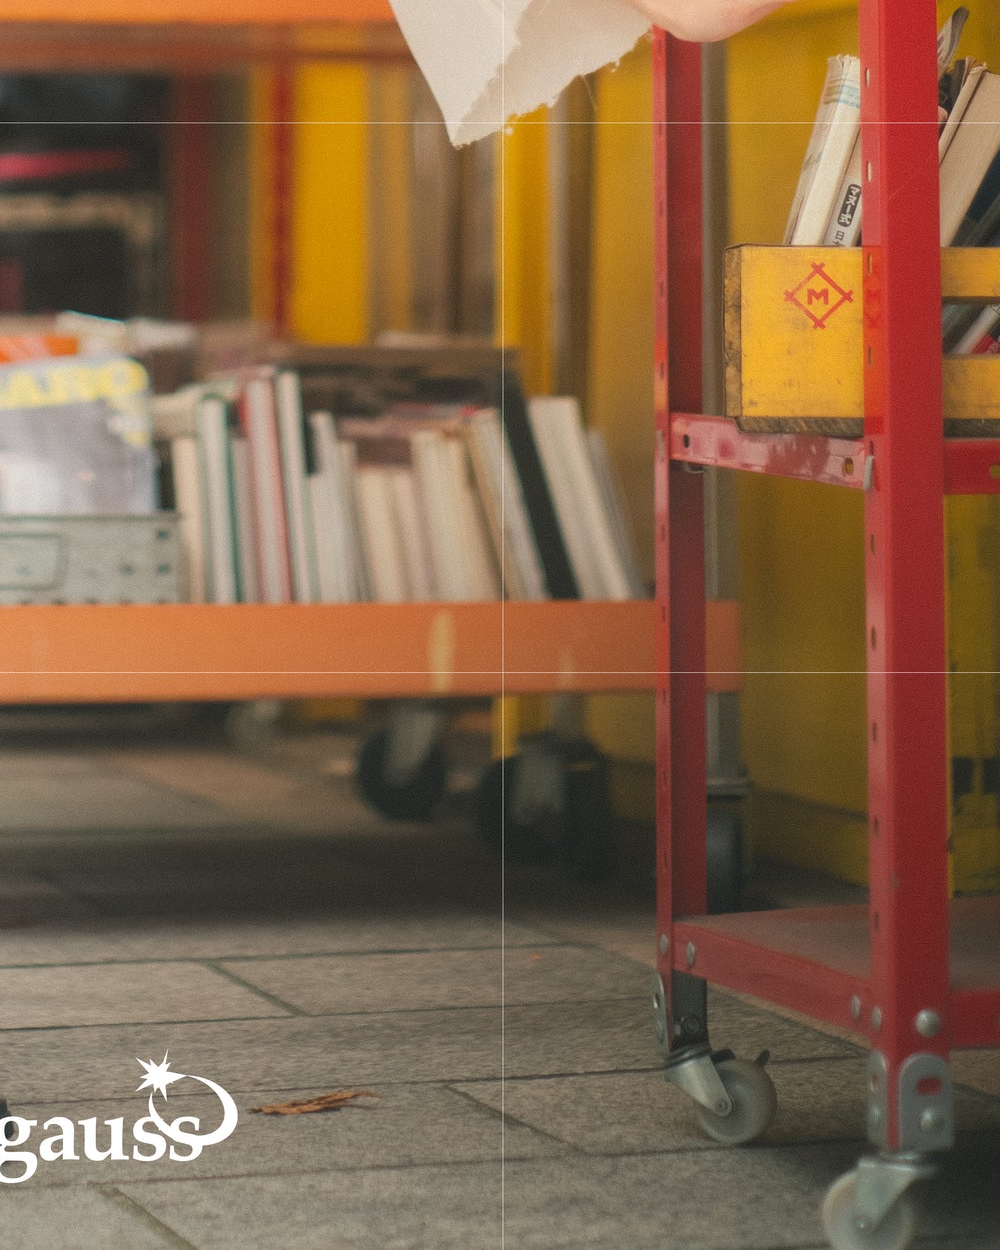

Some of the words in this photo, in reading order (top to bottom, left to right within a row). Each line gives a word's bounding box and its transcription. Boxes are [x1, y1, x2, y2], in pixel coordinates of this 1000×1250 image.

[838, 184, 861, 227] マヌー式
[806, 288, 829, 305] M
